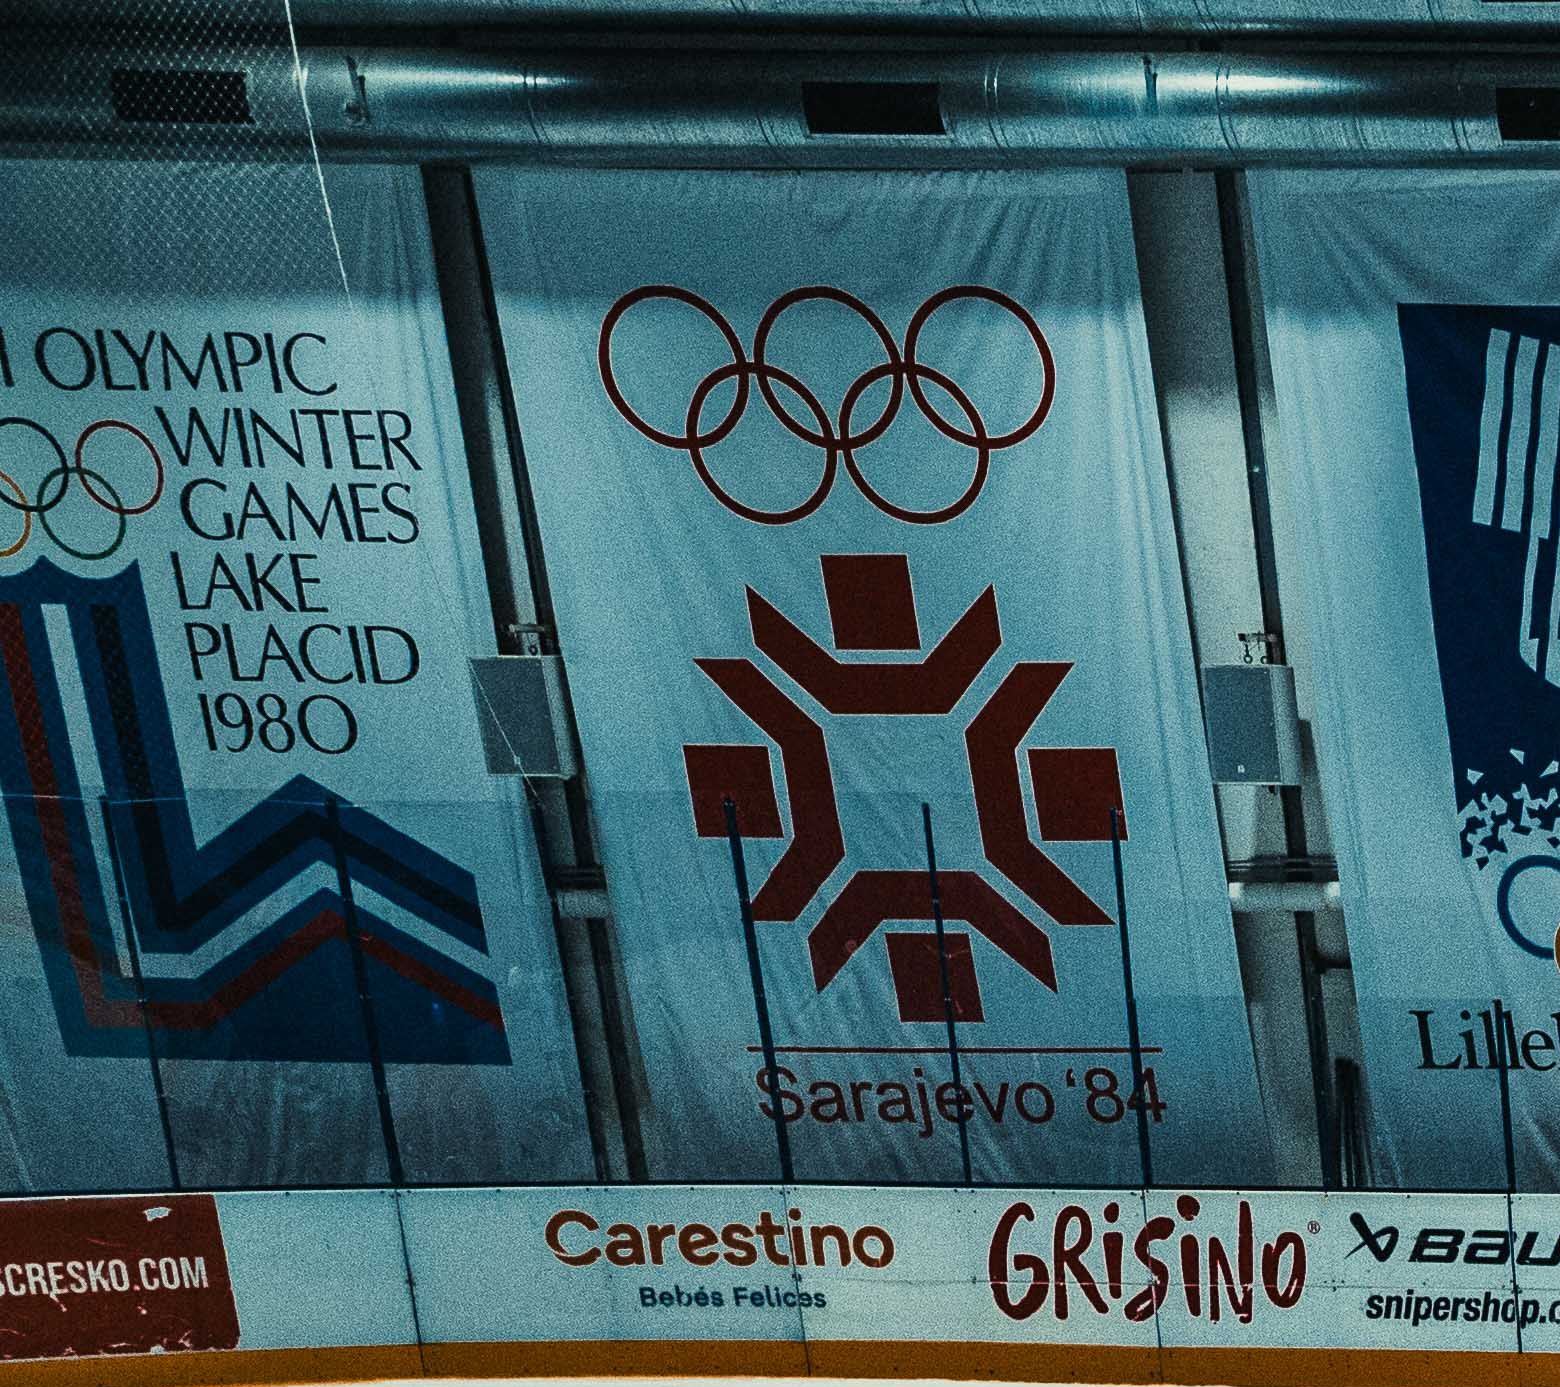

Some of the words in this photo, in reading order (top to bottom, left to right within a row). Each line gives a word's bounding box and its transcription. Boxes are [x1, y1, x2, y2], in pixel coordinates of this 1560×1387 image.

[35, 327, 337, 395] OLYMPIC
[155, 406, 423, 471] WINTER
[180, 477, 420, 544] GAMES
[170, 551, 329, 612] LAKE
[183, 622, 421, 685] PLACID
[197, 691, 358, 754] 1980
[755, 1065, 1055, 1139] Sarajevo
[545, 1209, 895, 1268] Carestino
[639, 1285, 724, 1309] Bebés
[733, 1285, 827, 1309] Felices
